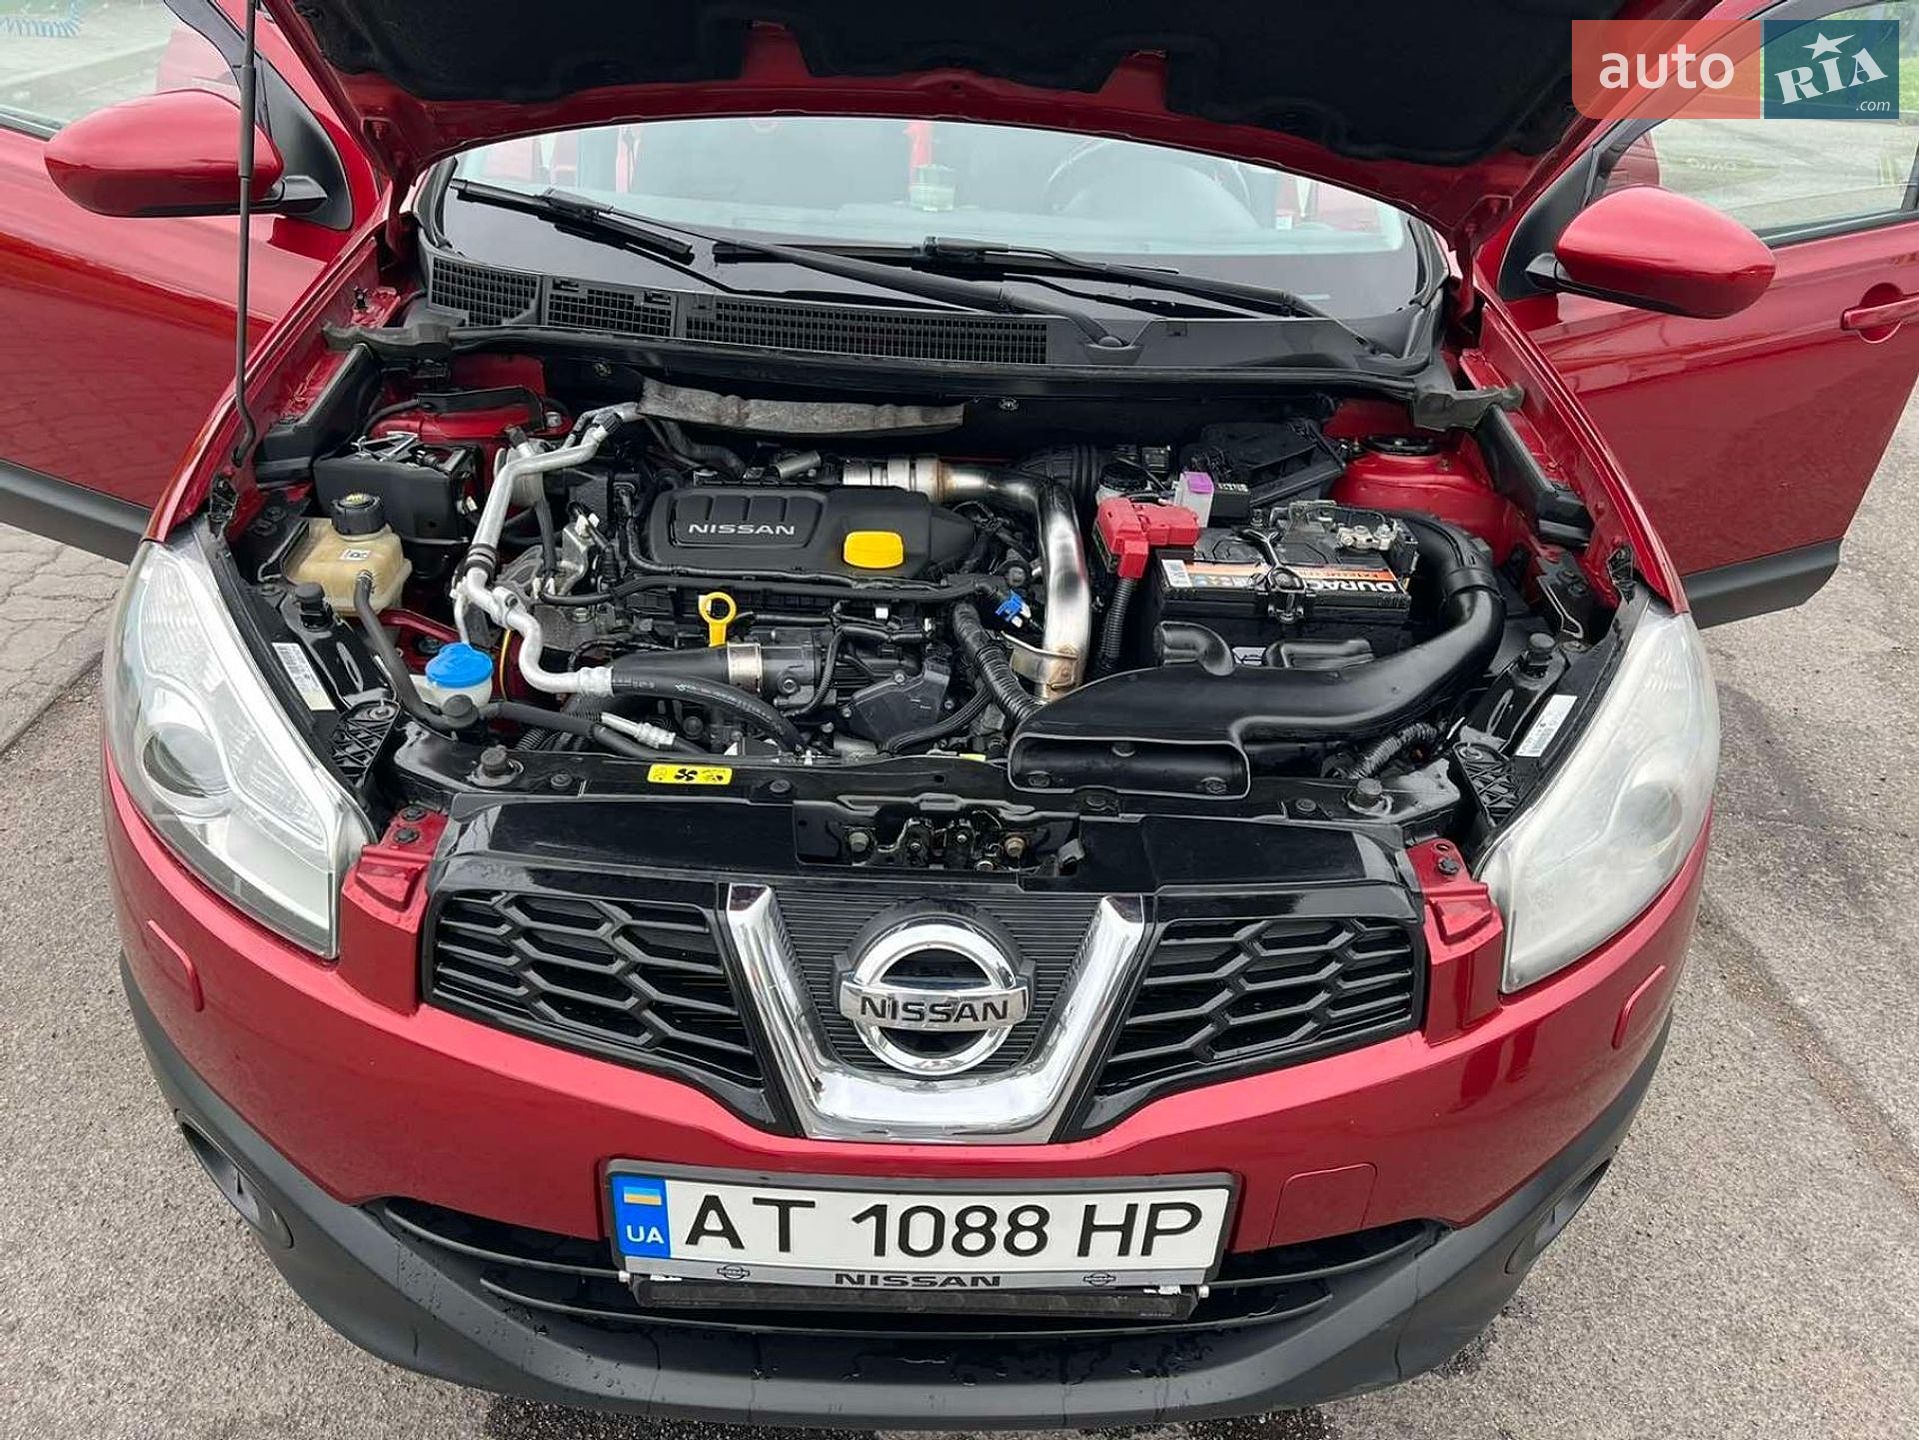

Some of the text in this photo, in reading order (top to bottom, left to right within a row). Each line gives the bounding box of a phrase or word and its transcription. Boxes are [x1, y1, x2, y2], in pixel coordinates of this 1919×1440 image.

[688, 523, 796, 536] NISSAN
[1305, 579, 1397, 592] DURAC
[860, 996, 1009, 1024] NISSAN
[626, 1224, 666, 1247] UA
[684, 1193, 1204, 1259] AT 1088 HP
[834, 1272, 1001, 1288] NISSAN
